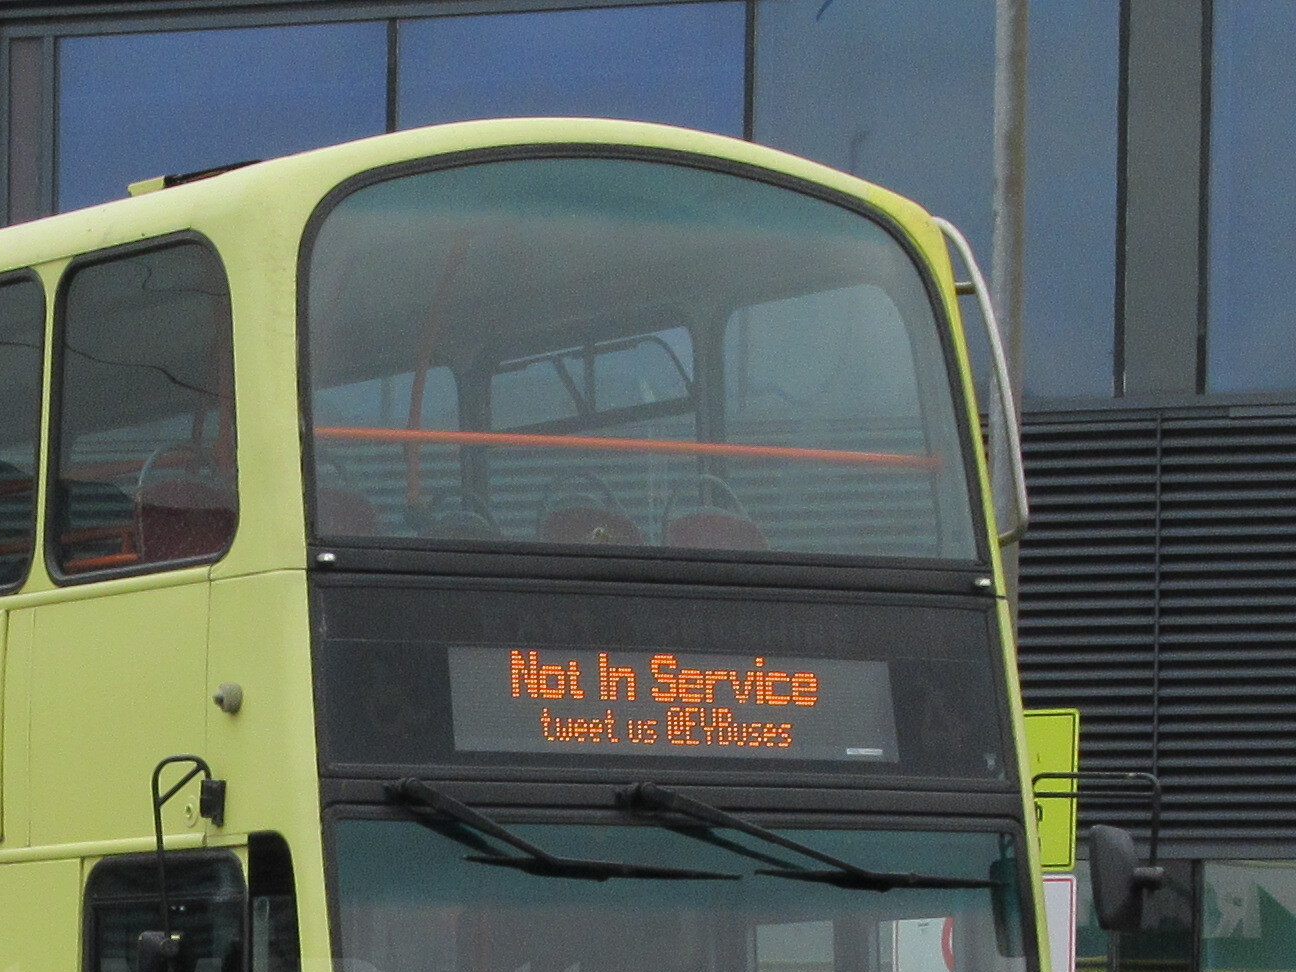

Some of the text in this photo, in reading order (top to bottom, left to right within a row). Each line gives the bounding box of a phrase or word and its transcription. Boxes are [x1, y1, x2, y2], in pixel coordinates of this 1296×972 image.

[510, 650, 819, 706] Not In Service
[541, 706, 793, 747] tweet us @EYBuses
